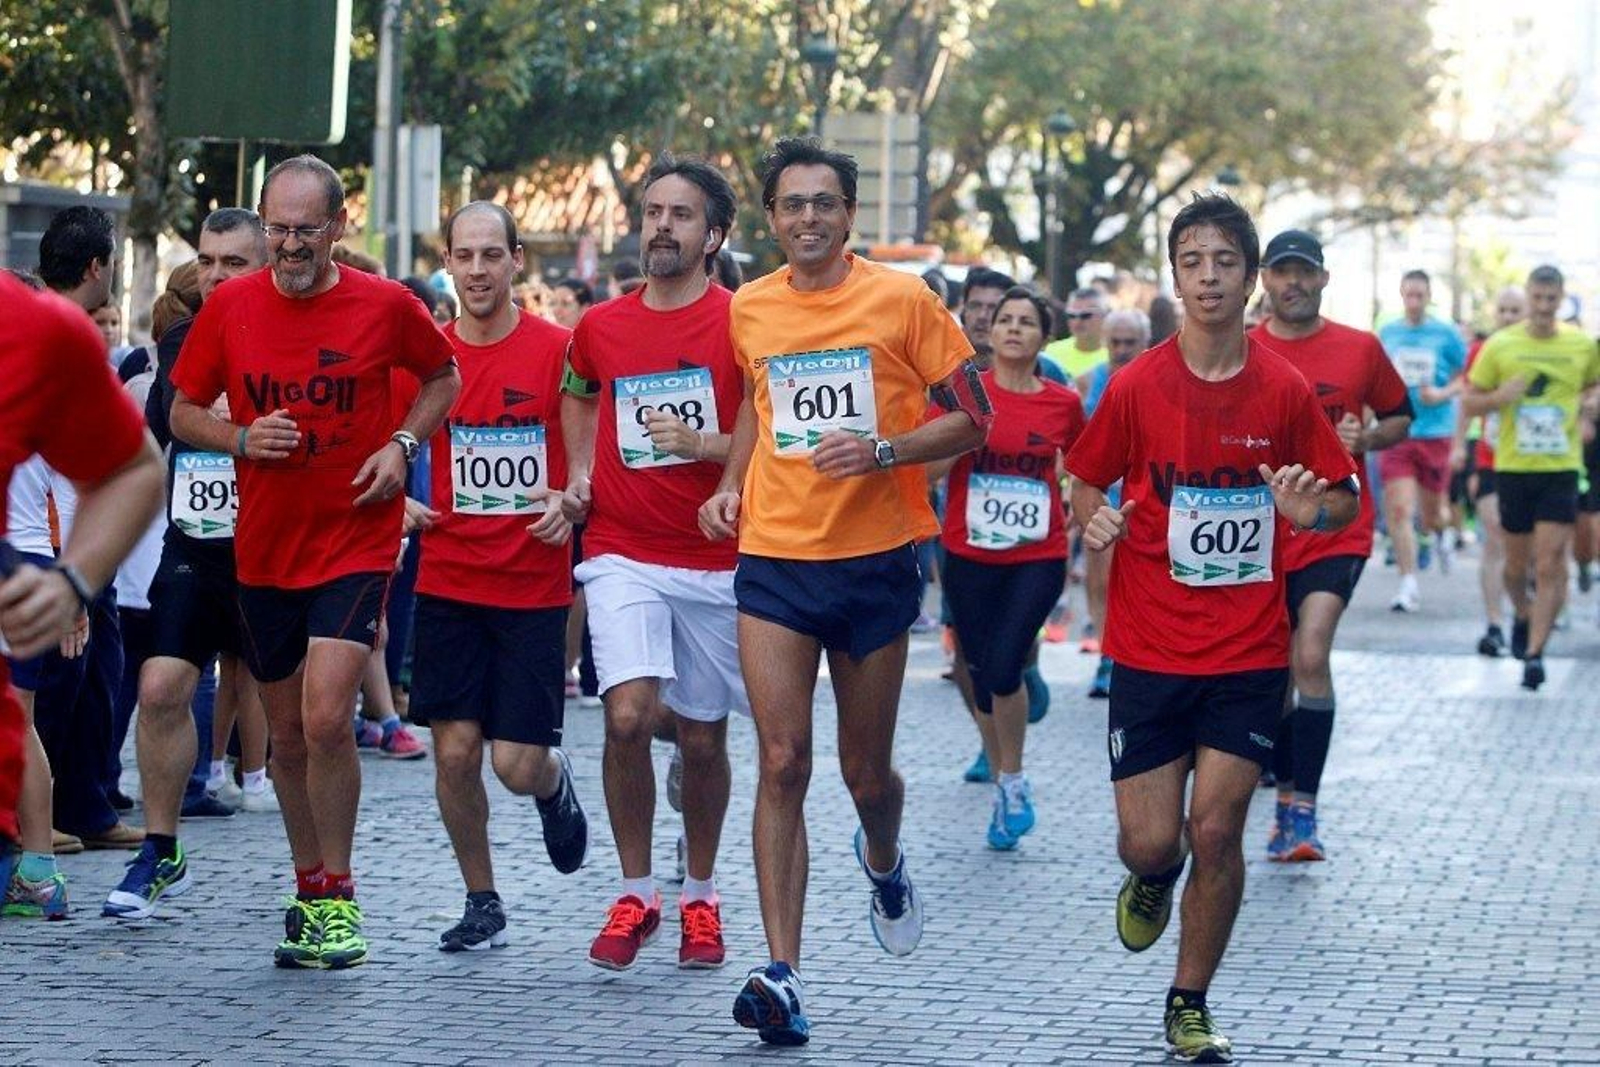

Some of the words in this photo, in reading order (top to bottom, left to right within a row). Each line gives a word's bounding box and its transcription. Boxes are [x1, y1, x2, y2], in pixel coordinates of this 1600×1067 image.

[793, 382, 862, 421] 601
[455, 456, 539, 488] 1000
[983, 498, 1039, 529] 968
[1190, 518, 1261, 555] 602
